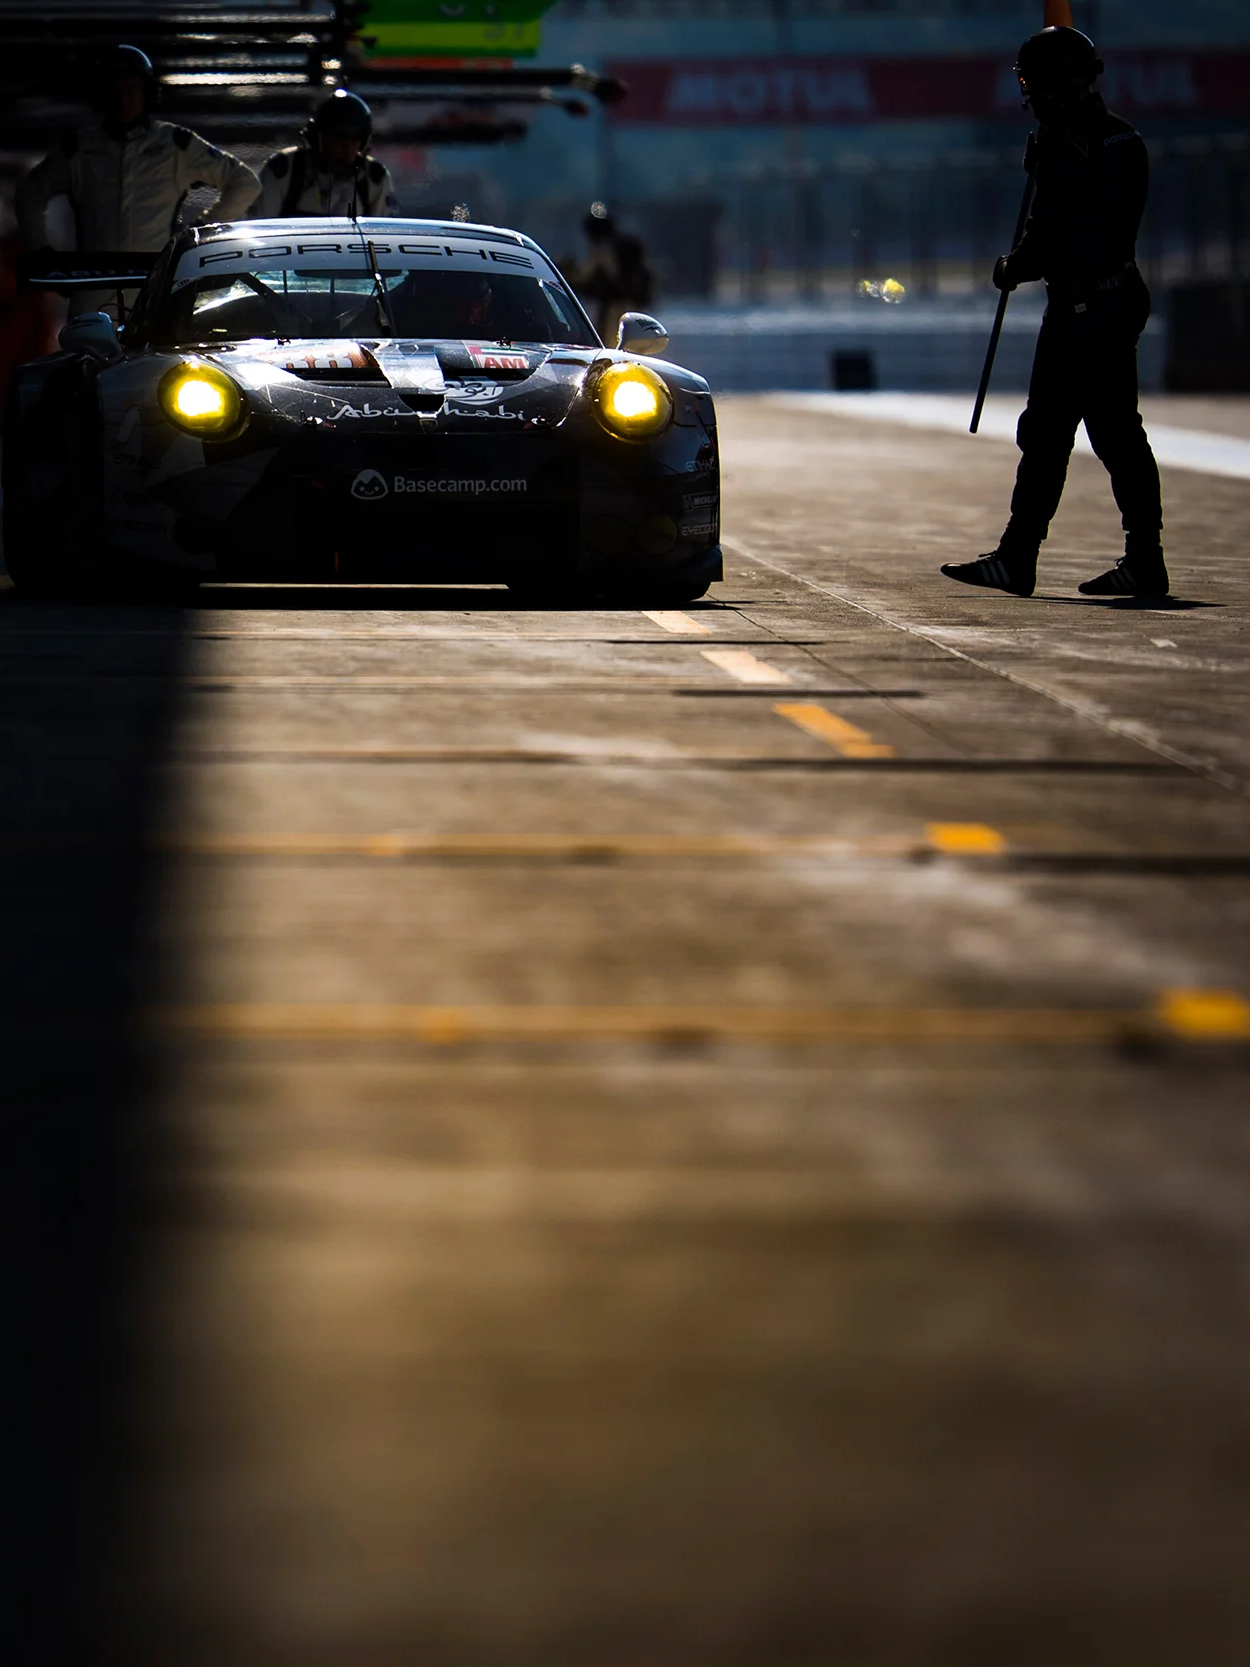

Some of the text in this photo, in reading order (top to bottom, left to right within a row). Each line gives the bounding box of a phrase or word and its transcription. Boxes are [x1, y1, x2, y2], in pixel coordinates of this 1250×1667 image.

[665, 68, 871, 113] MOTUL
[199, 243, 534, 269] PORSCHE
[483, 356, 526, 369] AM
[327, 402, 525, 421] Abu habi
[393, 475, 528, 496] Basecamp.com
